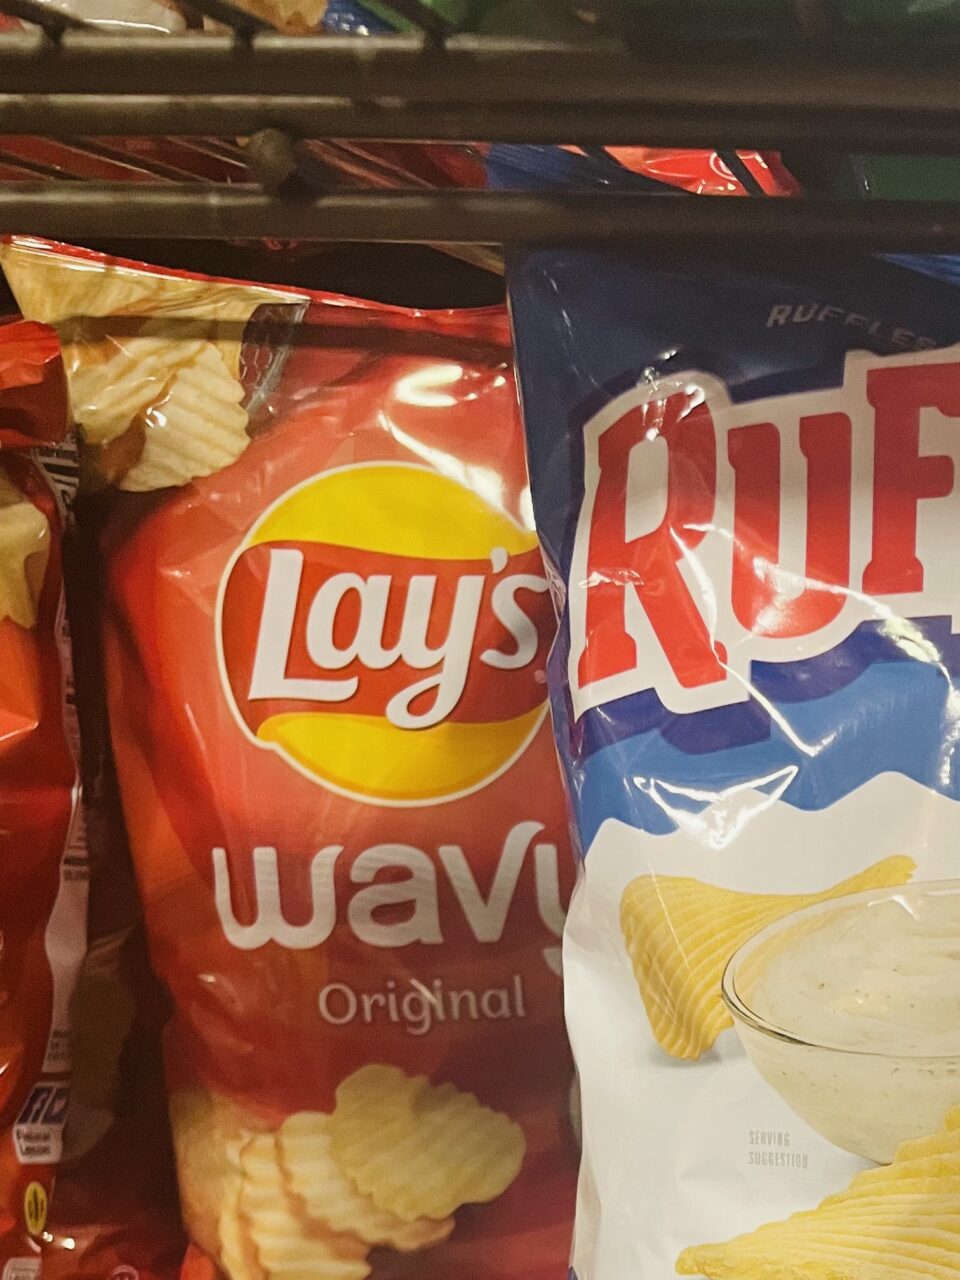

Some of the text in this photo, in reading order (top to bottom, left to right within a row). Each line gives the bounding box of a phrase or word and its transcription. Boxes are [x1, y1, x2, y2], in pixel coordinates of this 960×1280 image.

[247, 546, 552, 729] Lay's
[318, 977, 526, 1034] Original
[749, 1130, 790, 1146] SERVING
[748, 1151, 808, 1169] SUGGESTION
